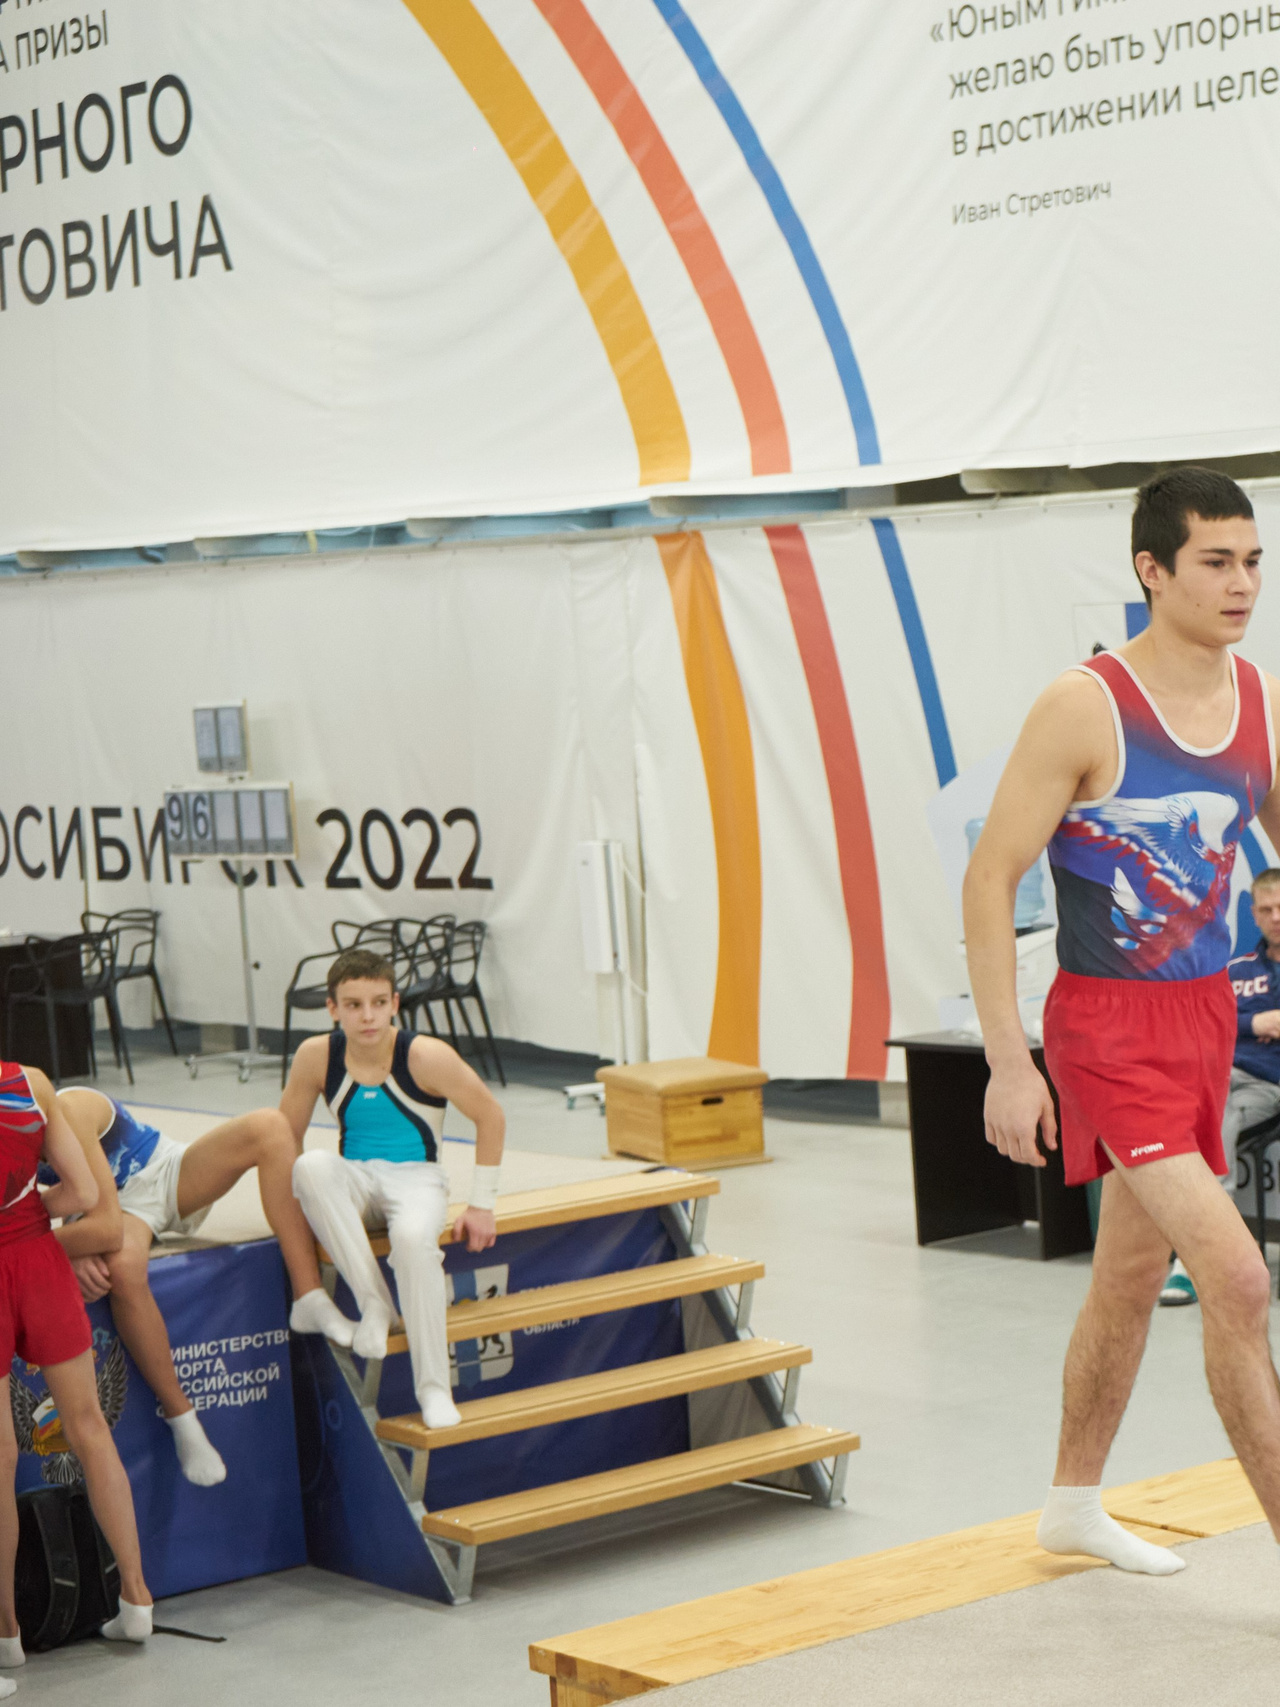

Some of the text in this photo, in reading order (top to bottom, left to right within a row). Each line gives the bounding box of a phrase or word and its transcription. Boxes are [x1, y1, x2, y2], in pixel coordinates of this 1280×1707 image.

[16, 9, 108, 70] ПРИЗЫ
[949, 53, 1055, 100] желаю
[1065, 33, 1145, 73] быть
[953, 129, 968, 156] в
[976, 85, 1182, 157] достижении
[952, 181, 1112, 225] Иван Стретович
[316, 808, 495, 891] 2022
